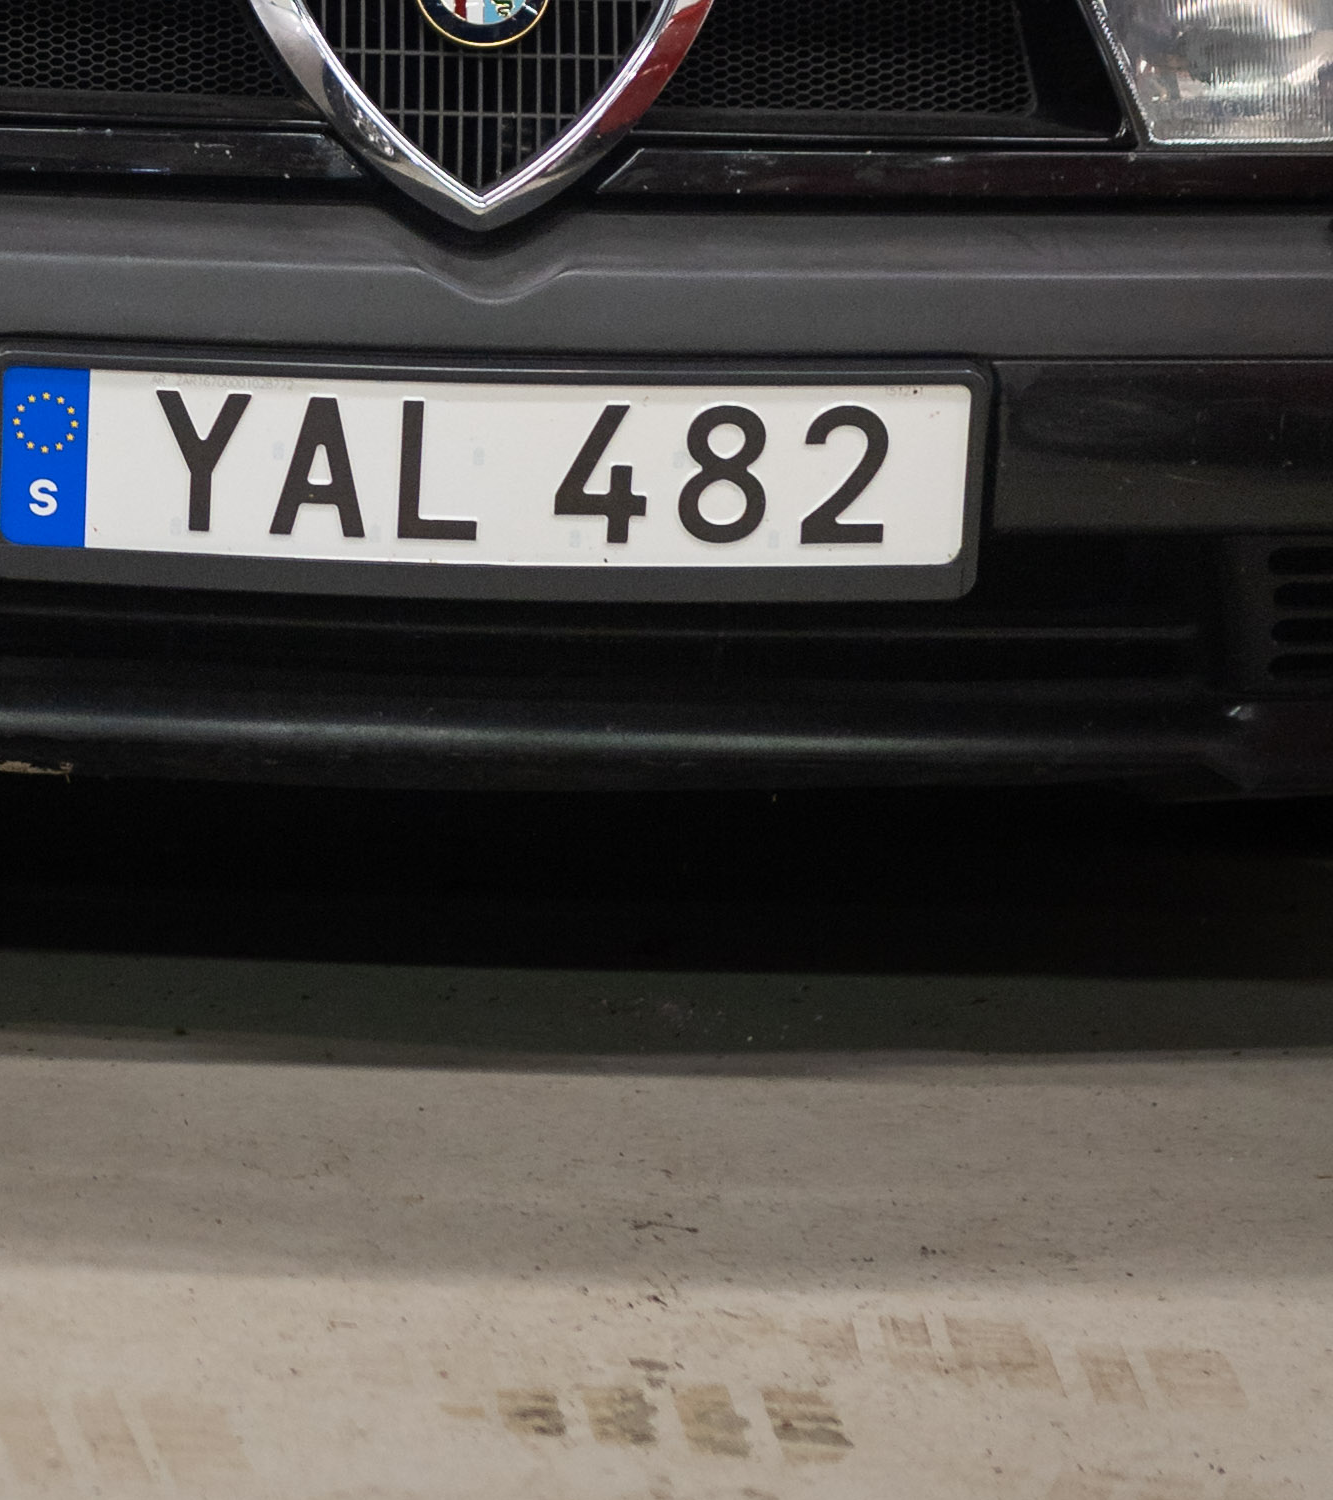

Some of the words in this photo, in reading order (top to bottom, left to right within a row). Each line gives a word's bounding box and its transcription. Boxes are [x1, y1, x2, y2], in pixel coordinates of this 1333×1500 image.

[29, 478, 59, 517] S
[156, 389, 478, 541] YAL
[554, 404, 890, 545] 482
